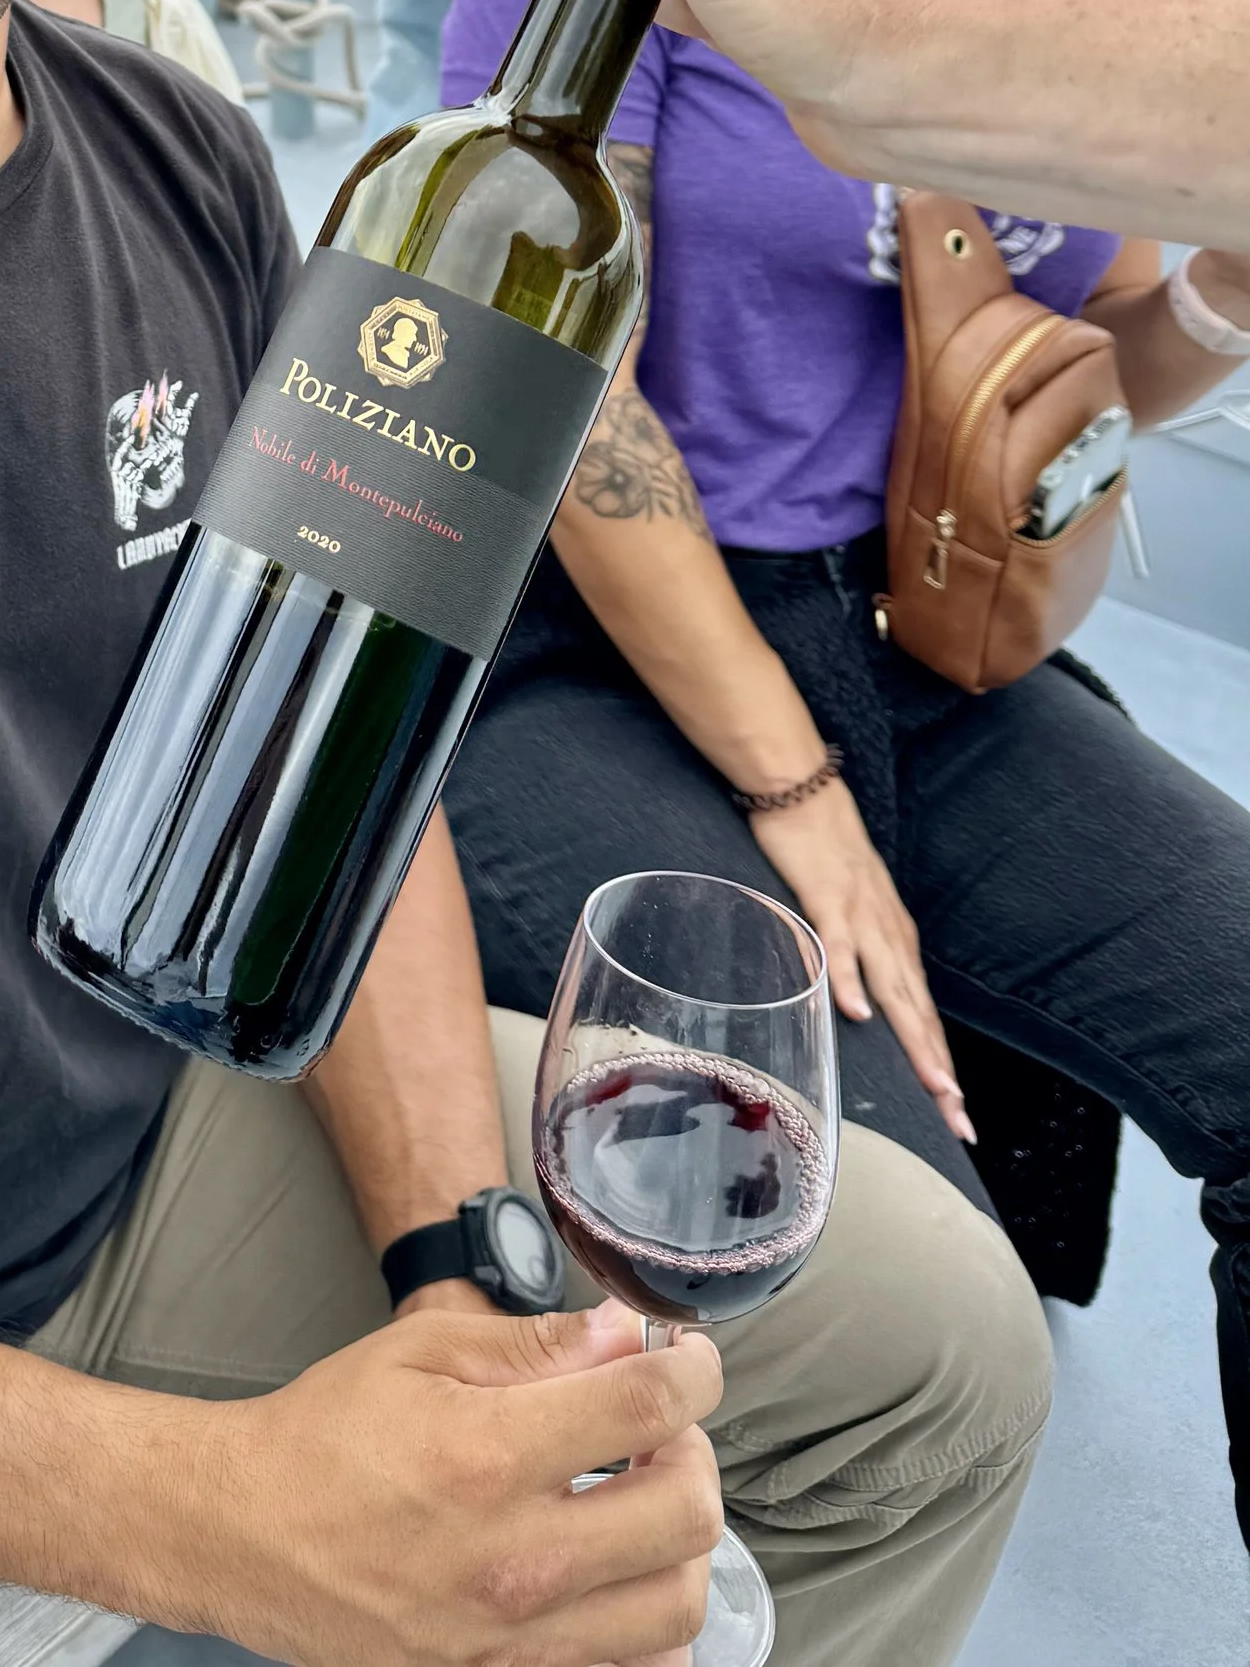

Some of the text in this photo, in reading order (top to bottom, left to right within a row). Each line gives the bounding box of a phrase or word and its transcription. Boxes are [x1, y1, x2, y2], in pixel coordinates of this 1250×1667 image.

[279, 357, 477, 472] POLIZIANO
[247, 424, 463, 542] Nobile di Montepulciano
[296, 525, 341, 553] 2020
